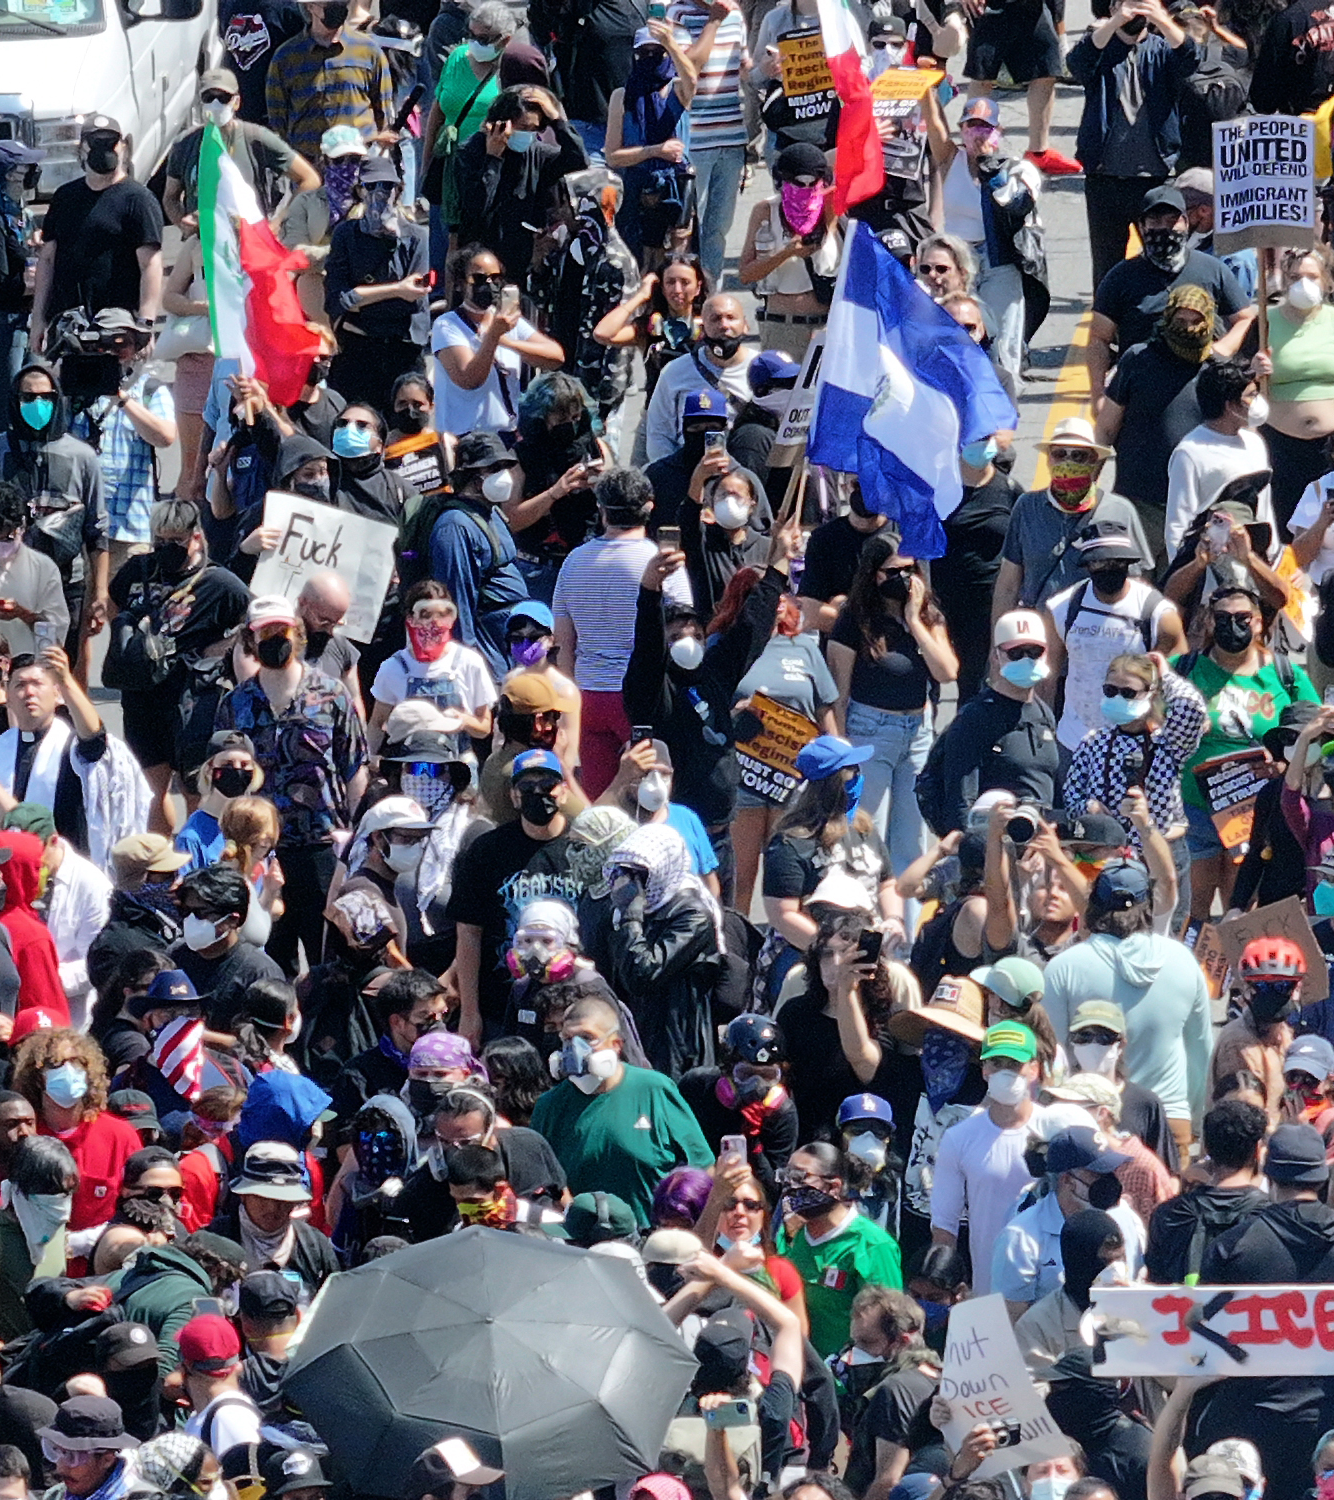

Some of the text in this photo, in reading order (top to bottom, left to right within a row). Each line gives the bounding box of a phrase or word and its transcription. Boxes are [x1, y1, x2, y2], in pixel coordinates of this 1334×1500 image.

[1219, 120, 1308, 143] THE PEOPLE
[1220, 140, 1308, 168] UNITED
[1220, 161, 1308, 182] WILL DEFEND
[1220, 187, 1308, 209] IMMIGRANT
[1220, 204, 1308, 228] FAMILIES!
[278, 511, 343, 568] Fuck
[741, 772, 789, 803] OW!!!
[961, 1396, 1014, 1420] ICE
